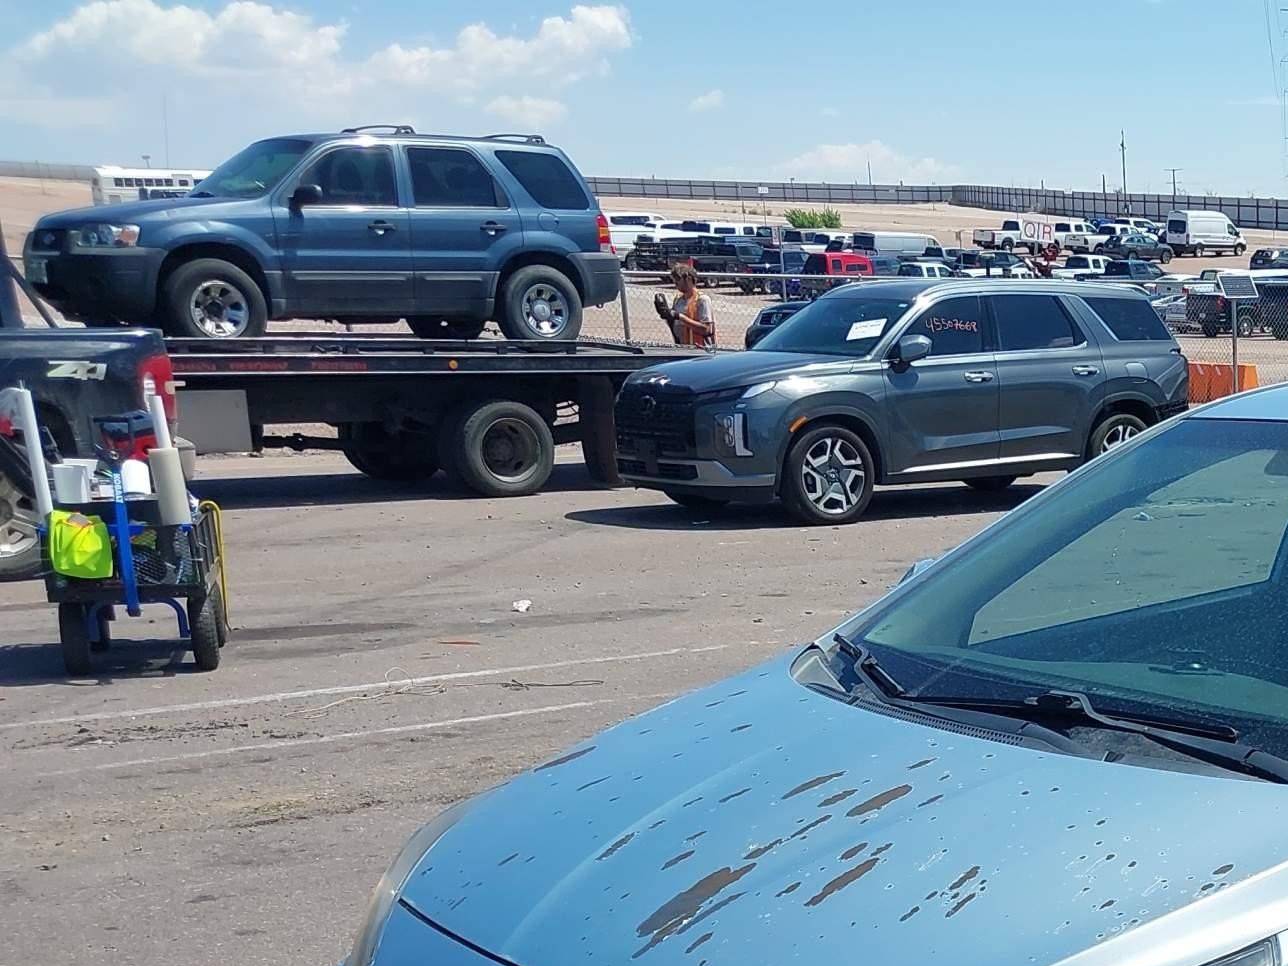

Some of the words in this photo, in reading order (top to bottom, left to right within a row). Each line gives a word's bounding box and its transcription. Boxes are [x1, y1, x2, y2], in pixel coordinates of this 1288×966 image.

[1024, 222, 1035, 239] Q
[1043, 224, 1052, 241] R
[113, 473, 124, 504] KOBALT
